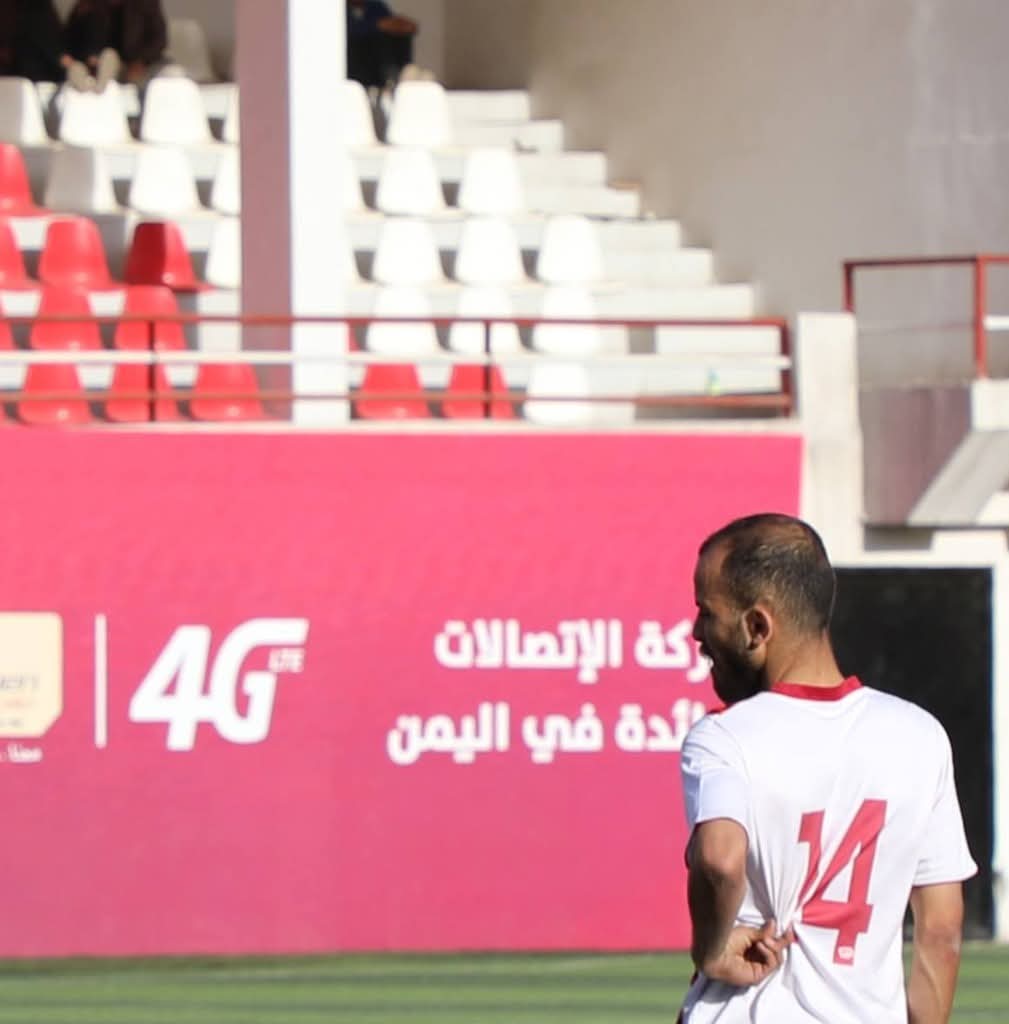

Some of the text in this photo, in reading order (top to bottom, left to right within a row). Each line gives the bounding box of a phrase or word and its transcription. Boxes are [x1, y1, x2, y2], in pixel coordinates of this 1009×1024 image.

[128, 617, 310, 751] 4G
[433, 618, 714, 684] ركة الإتصالات
[386, 698, 706, 766] ئدة في اليمن
[797, 798, 888, 967] 14
